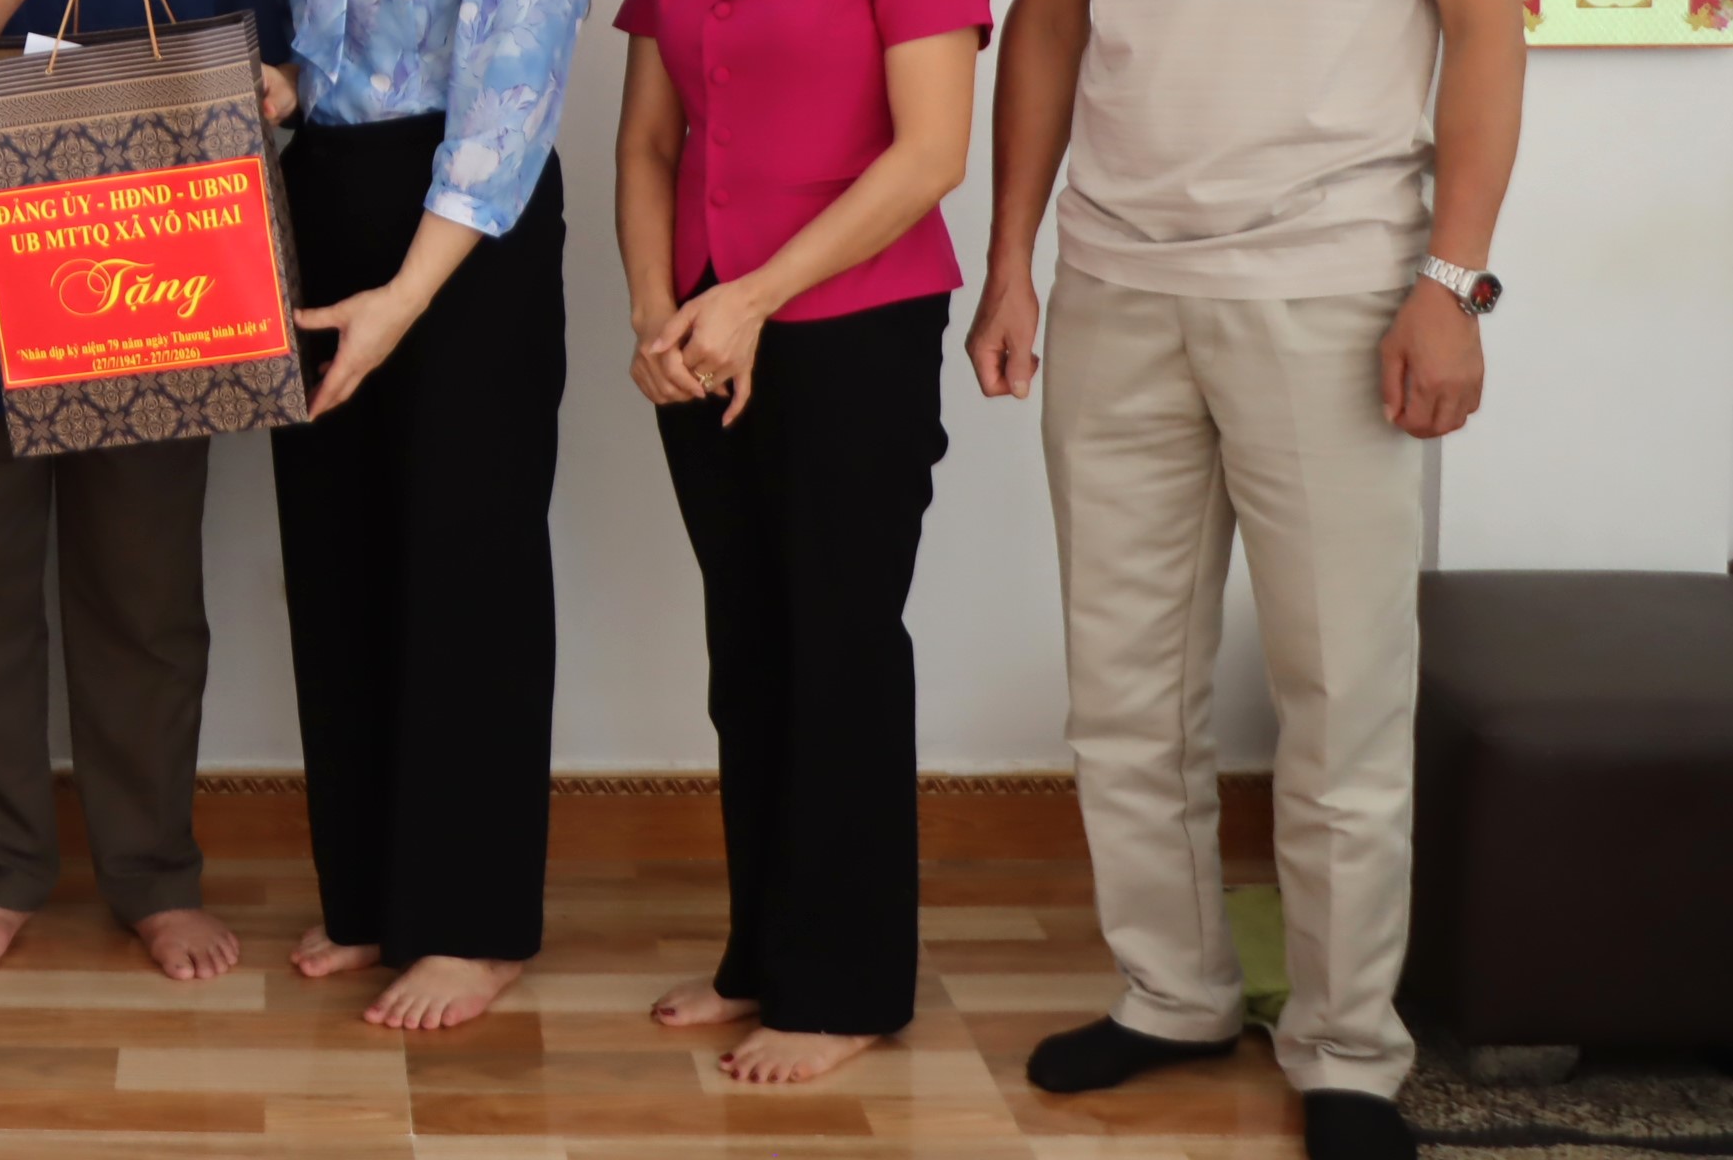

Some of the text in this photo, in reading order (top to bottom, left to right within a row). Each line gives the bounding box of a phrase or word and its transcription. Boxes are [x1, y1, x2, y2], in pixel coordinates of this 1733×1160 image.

[61, 190, 92, 217] ỦY
[109, 184, 172, 211] HĐND
[188, 172, 249, 201] UBND
[10, 203, 243, 255] UB MTTQ XÃ VÕ NHAI
[50, 257, 215, 319] Tặng
[48, 344, 66, 361] dịp
[81, 341, 106, 357] niệm
[107, 339, 120, 351] 79
[122, 337, 144, 350] năm
[145, 333, 169, 349] ngày
[170, 328, 211, 345] Thương
[212, 323, 235, 338] binh
[236, 321, 257, 337] Liệt
